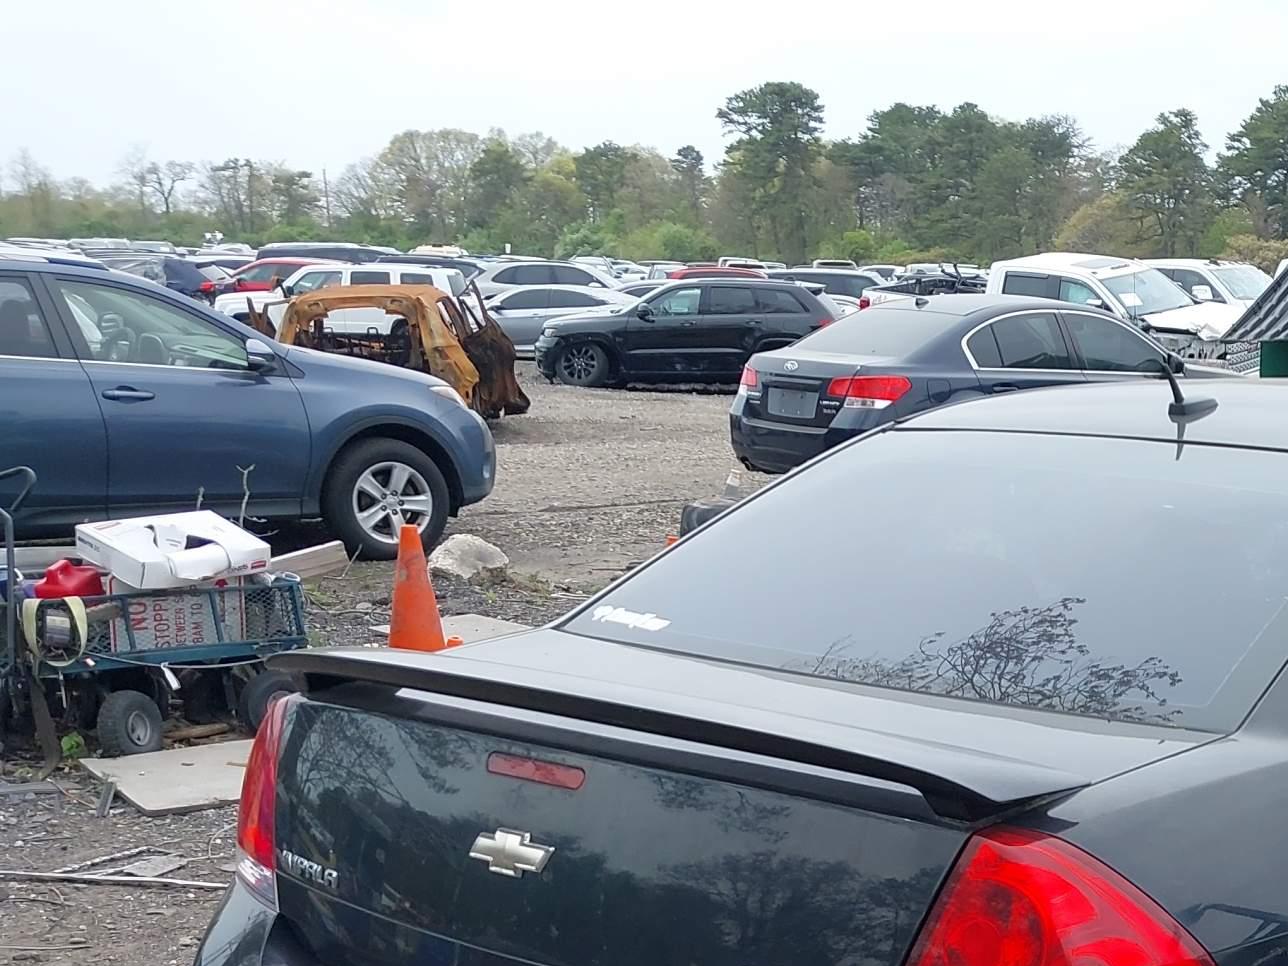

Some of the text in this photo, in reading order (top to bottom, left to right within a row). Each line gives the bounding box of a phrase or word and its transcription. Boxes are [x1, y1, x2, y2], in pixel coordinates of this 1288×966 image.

[128, 601, 149, 632] NO
[190, 602, 203, 617] TO
[191, 621, 204, 645] 8AM
